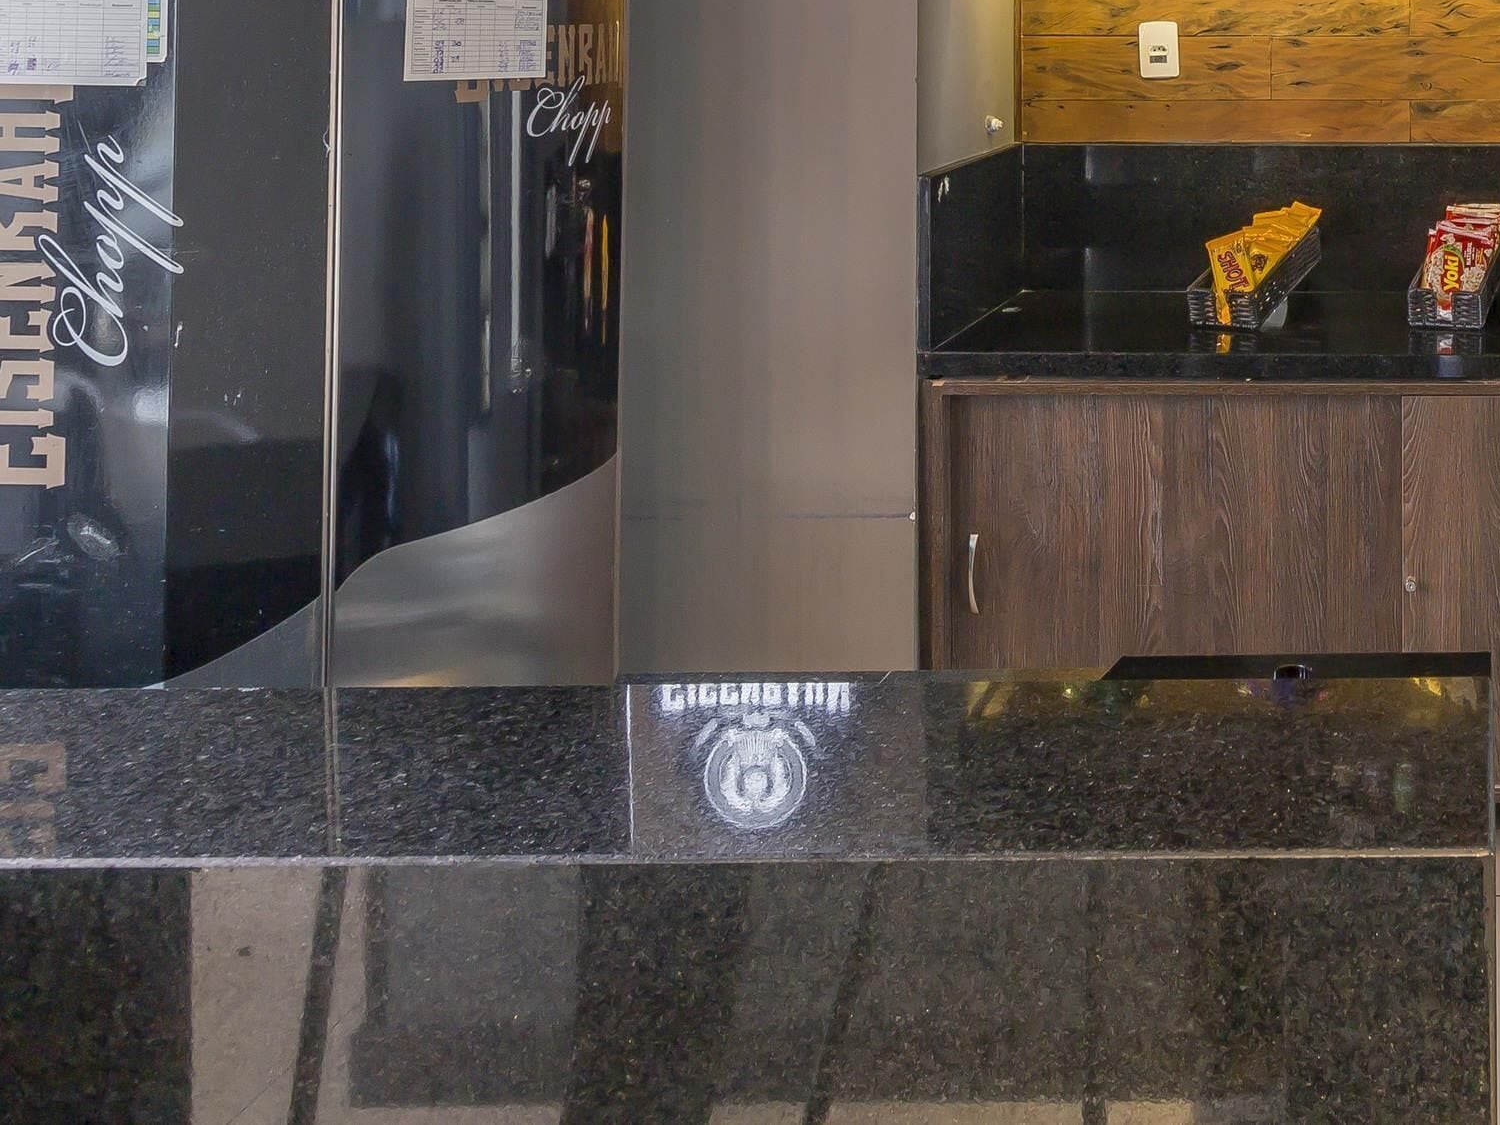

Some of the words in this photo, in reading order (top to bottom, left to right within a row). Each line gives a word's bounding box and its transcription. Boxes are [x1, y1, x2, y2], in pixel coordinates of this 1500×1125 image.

[527, 75, 612, 167] Chopp
[38, 133, 185, 367] Chopp
[1217, 250, 1251, 291] SHOT
[1443, 255, 1460, 291] Yoki
